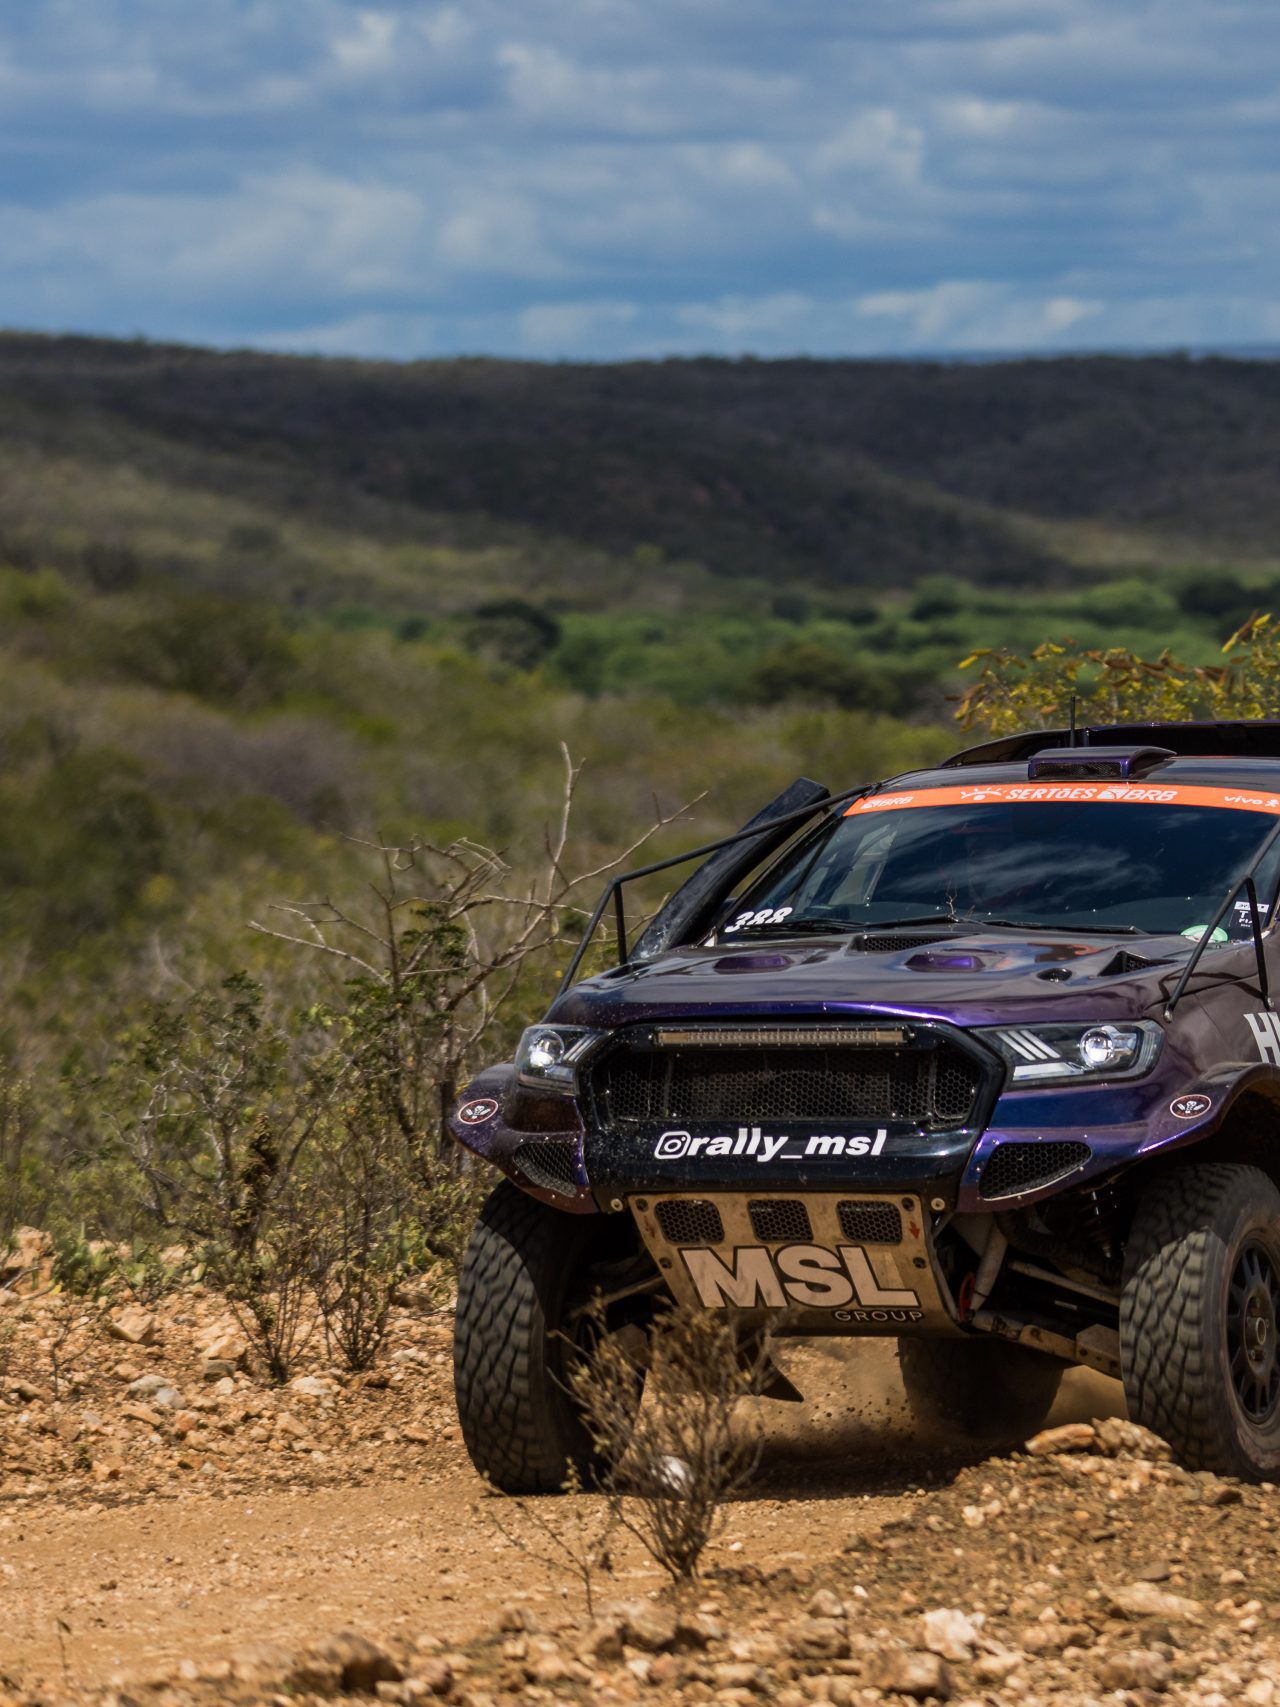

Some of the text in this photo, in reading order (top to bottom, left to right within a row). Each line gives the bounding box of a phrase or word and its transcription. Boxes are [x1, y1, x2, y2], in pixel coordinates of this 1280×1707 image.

[1123, 789, 1178, 801] BRB
[1224, 795, 1263, 805] vivo
[879, 796, 914, 807] BRB
[724, 906, 793, 933] 388
[677, 1242, 922, 1309] MSL
[833, 1310, 923, 1322] GROUP
